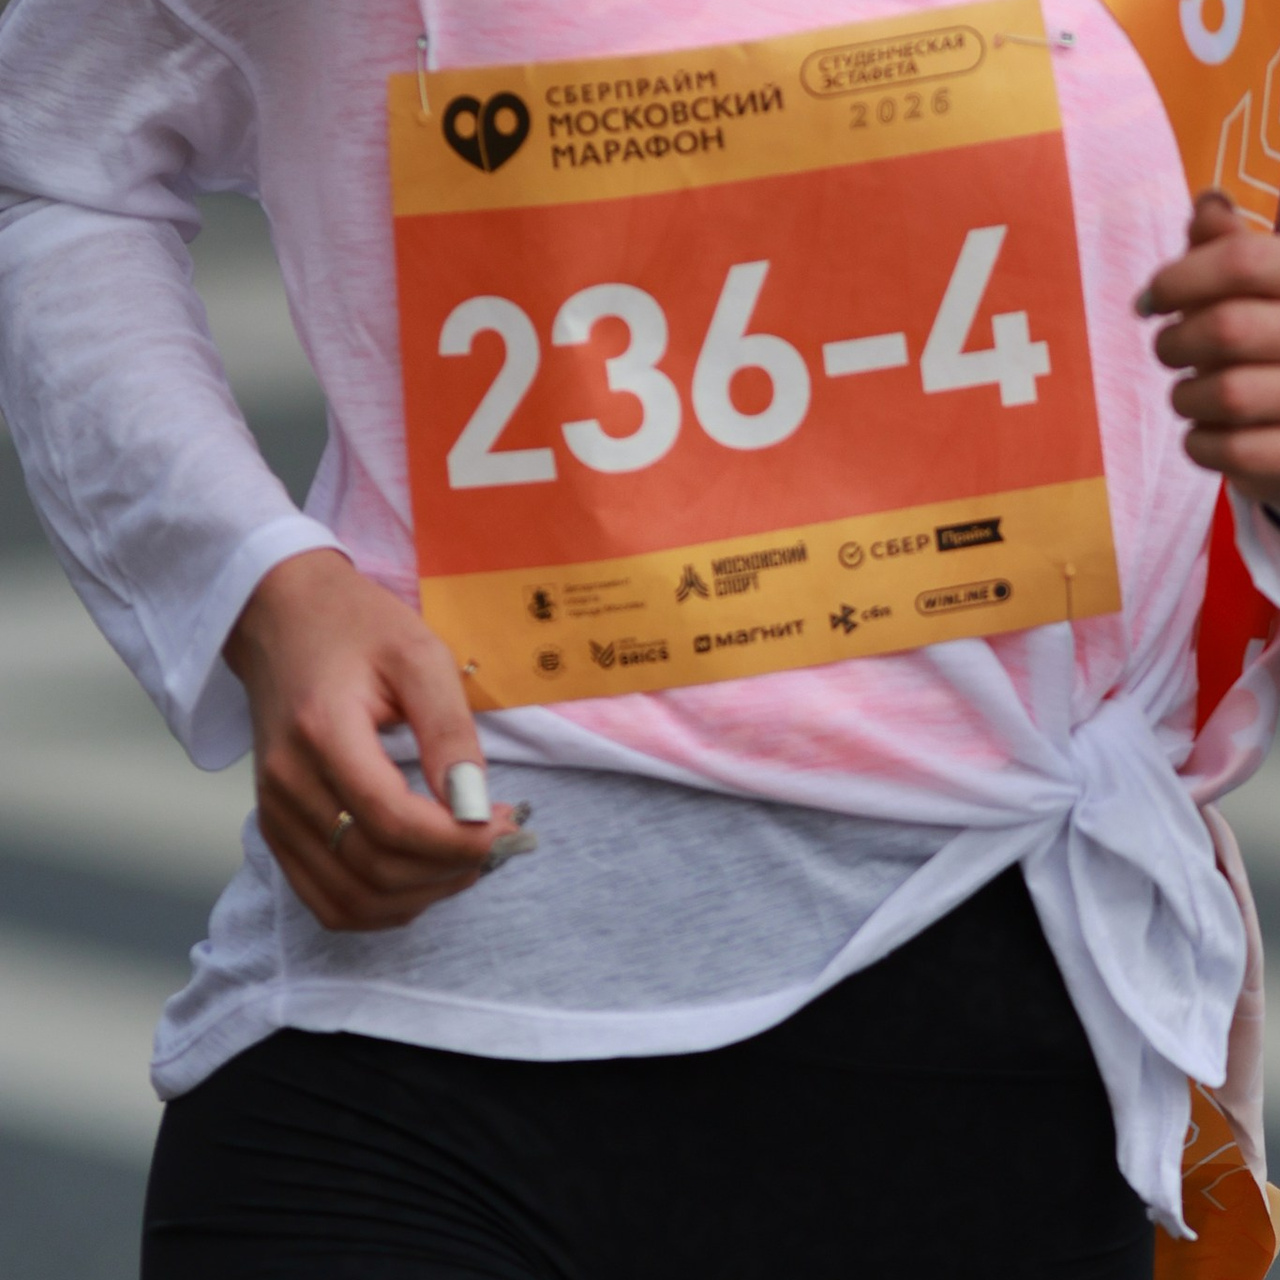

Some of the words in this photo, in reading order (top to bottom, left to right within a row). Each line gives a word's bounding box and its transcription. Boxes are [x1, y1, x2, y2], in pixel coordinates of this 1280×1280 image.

[818, 33, 965, 72] СТУДЕНЧЕСКАЯ
[545, 69, 717, 106] СБЕРПРАЙМ
[823, 59, 920, 89] ЭСТАФЕТА
[548, 82, 783, 137] МОСКОВСКИЙ
[850, 86, 951, 129] 2026
[551, 126, 724, 169] МАРАФОН
[438, 223, 1051, 489] 236-4
[711, 539, 808, 577] МОСКОВСКИЙ
[870, 533, 930, 560] СБЕР
[714, 572, 760, 597] СПОРТ
[924, 587, 989, 609] WINLINE
[619, 649, 669, 666] BRICS
